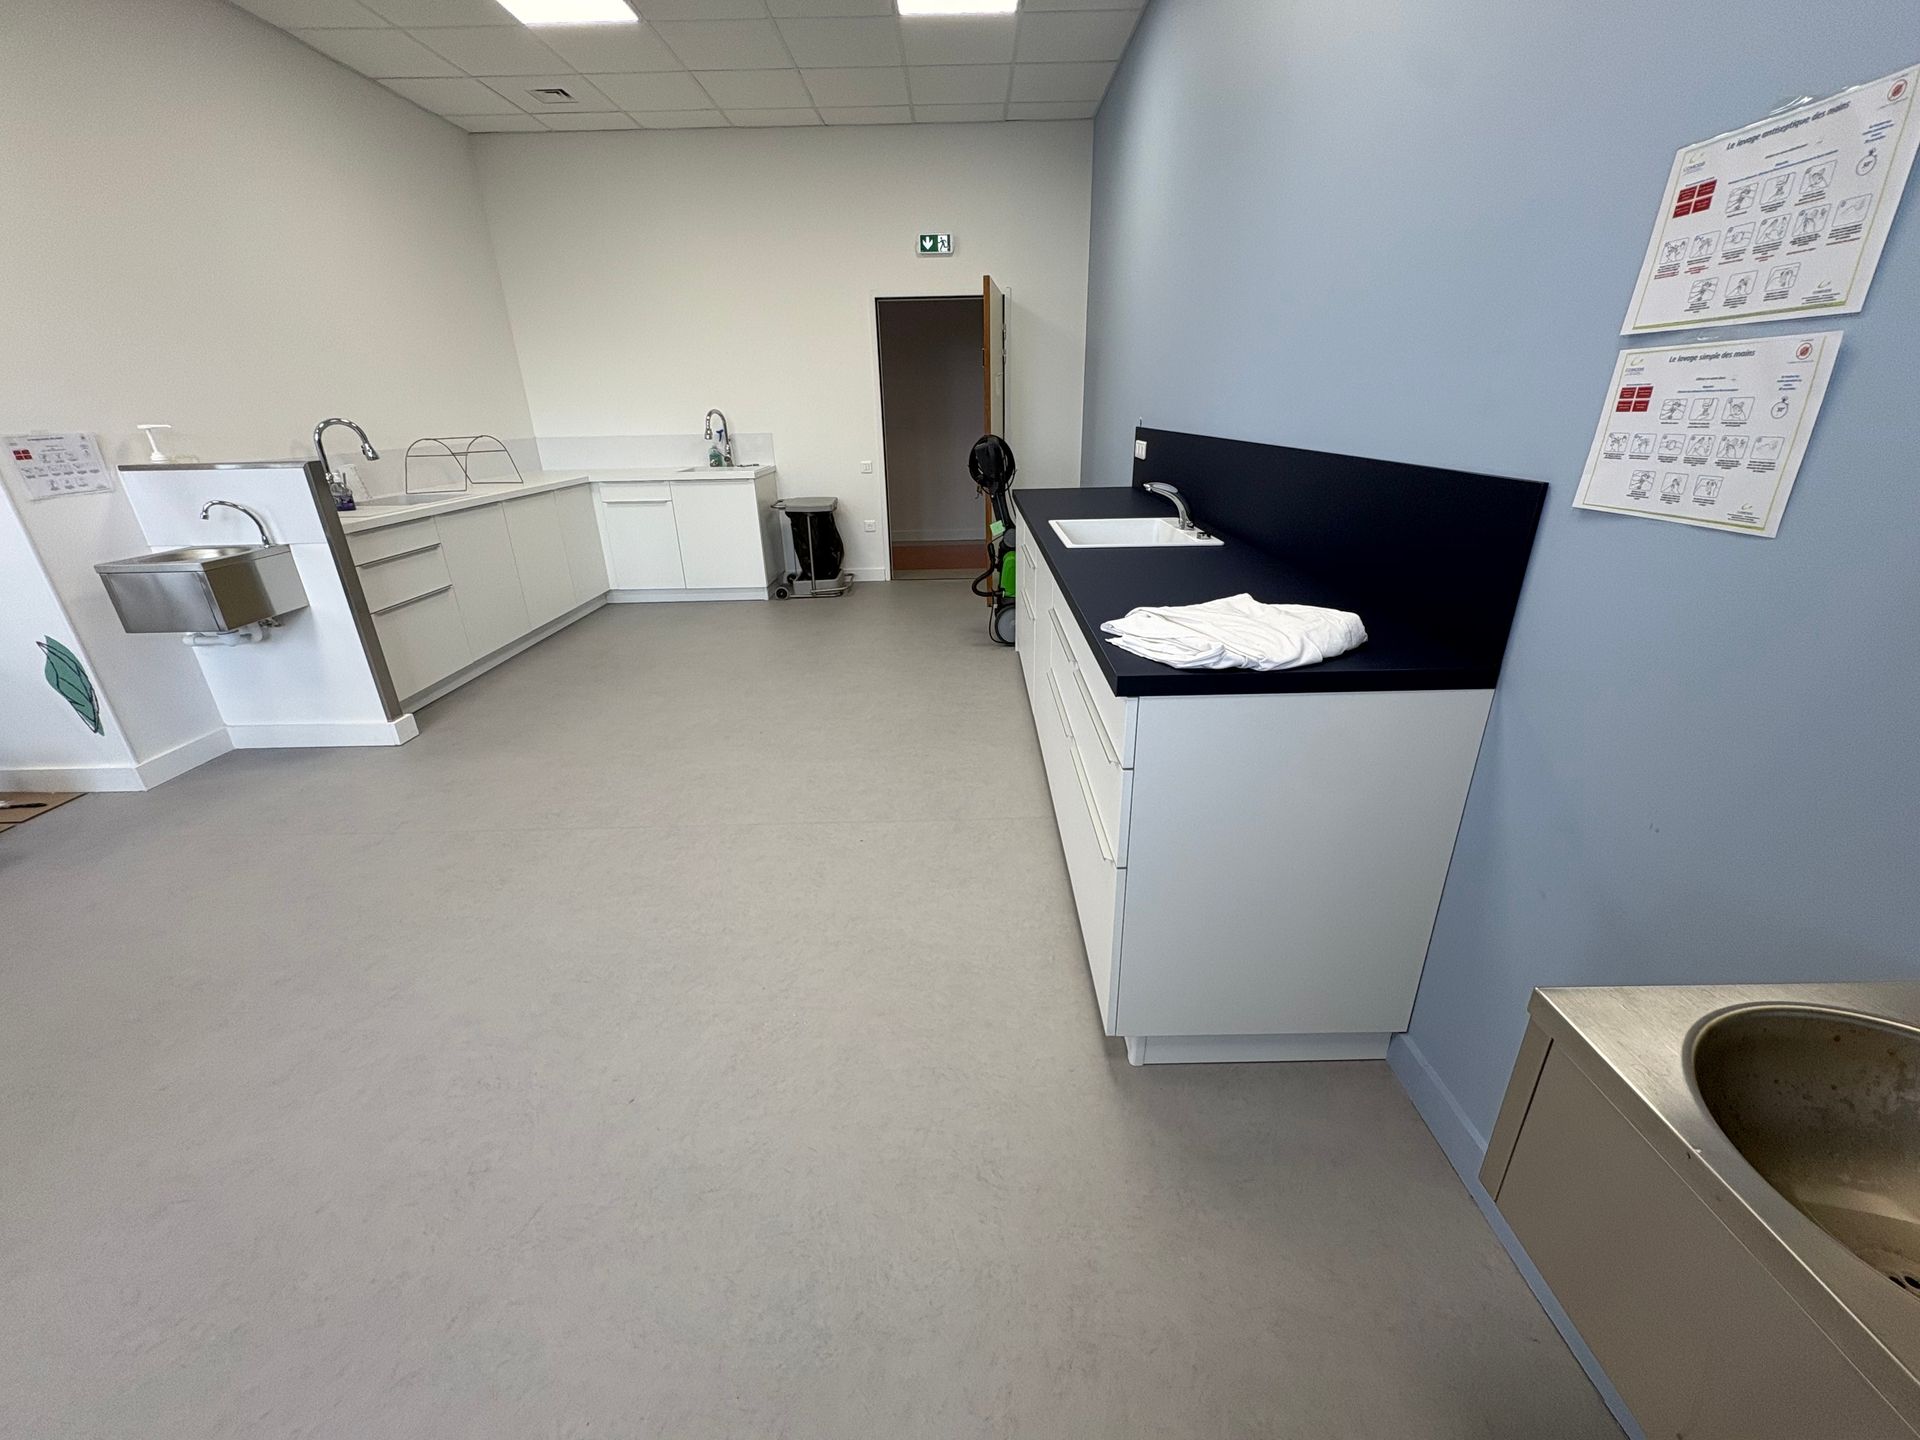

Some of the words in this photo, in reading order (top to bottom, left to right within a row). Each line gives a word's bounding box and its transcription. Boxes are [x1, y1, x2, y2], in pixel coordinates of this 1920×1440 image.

[1726, 142, 1736, 151] Le
[1677, 354, 1698, 362] lavage
[1698, 352, 1721, 361] simple
[1721, 351, 1733, 359] des
[1733, 349, 1756, 358] mains
